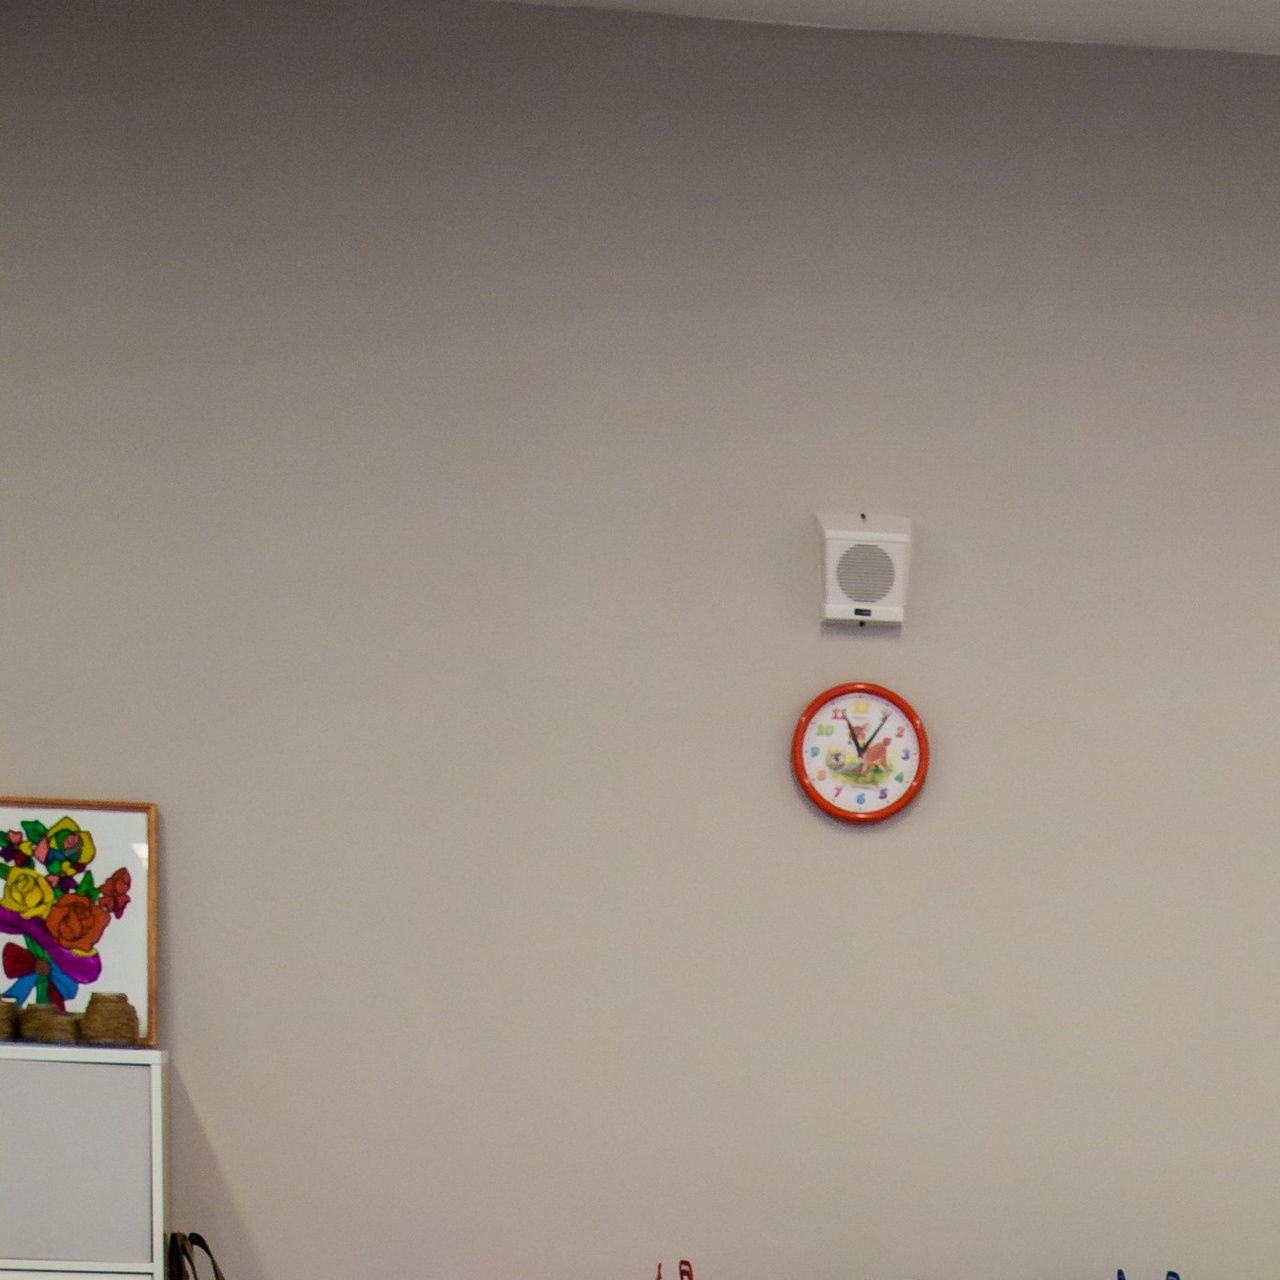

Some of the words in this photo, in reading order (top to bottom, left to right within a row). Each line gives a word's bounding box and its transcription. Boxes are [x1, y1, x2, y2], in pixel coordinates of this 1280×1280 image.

[895, 725, 905, 738] 2
[811, 745, 820, 757] 9
[902, 749, 910, 760] 3
[895, 771, 904, 783] 4
[834, 787, 843, 798] 7
[879, 788, 888, 800] 5
[856, 793, 866, 805] 6
